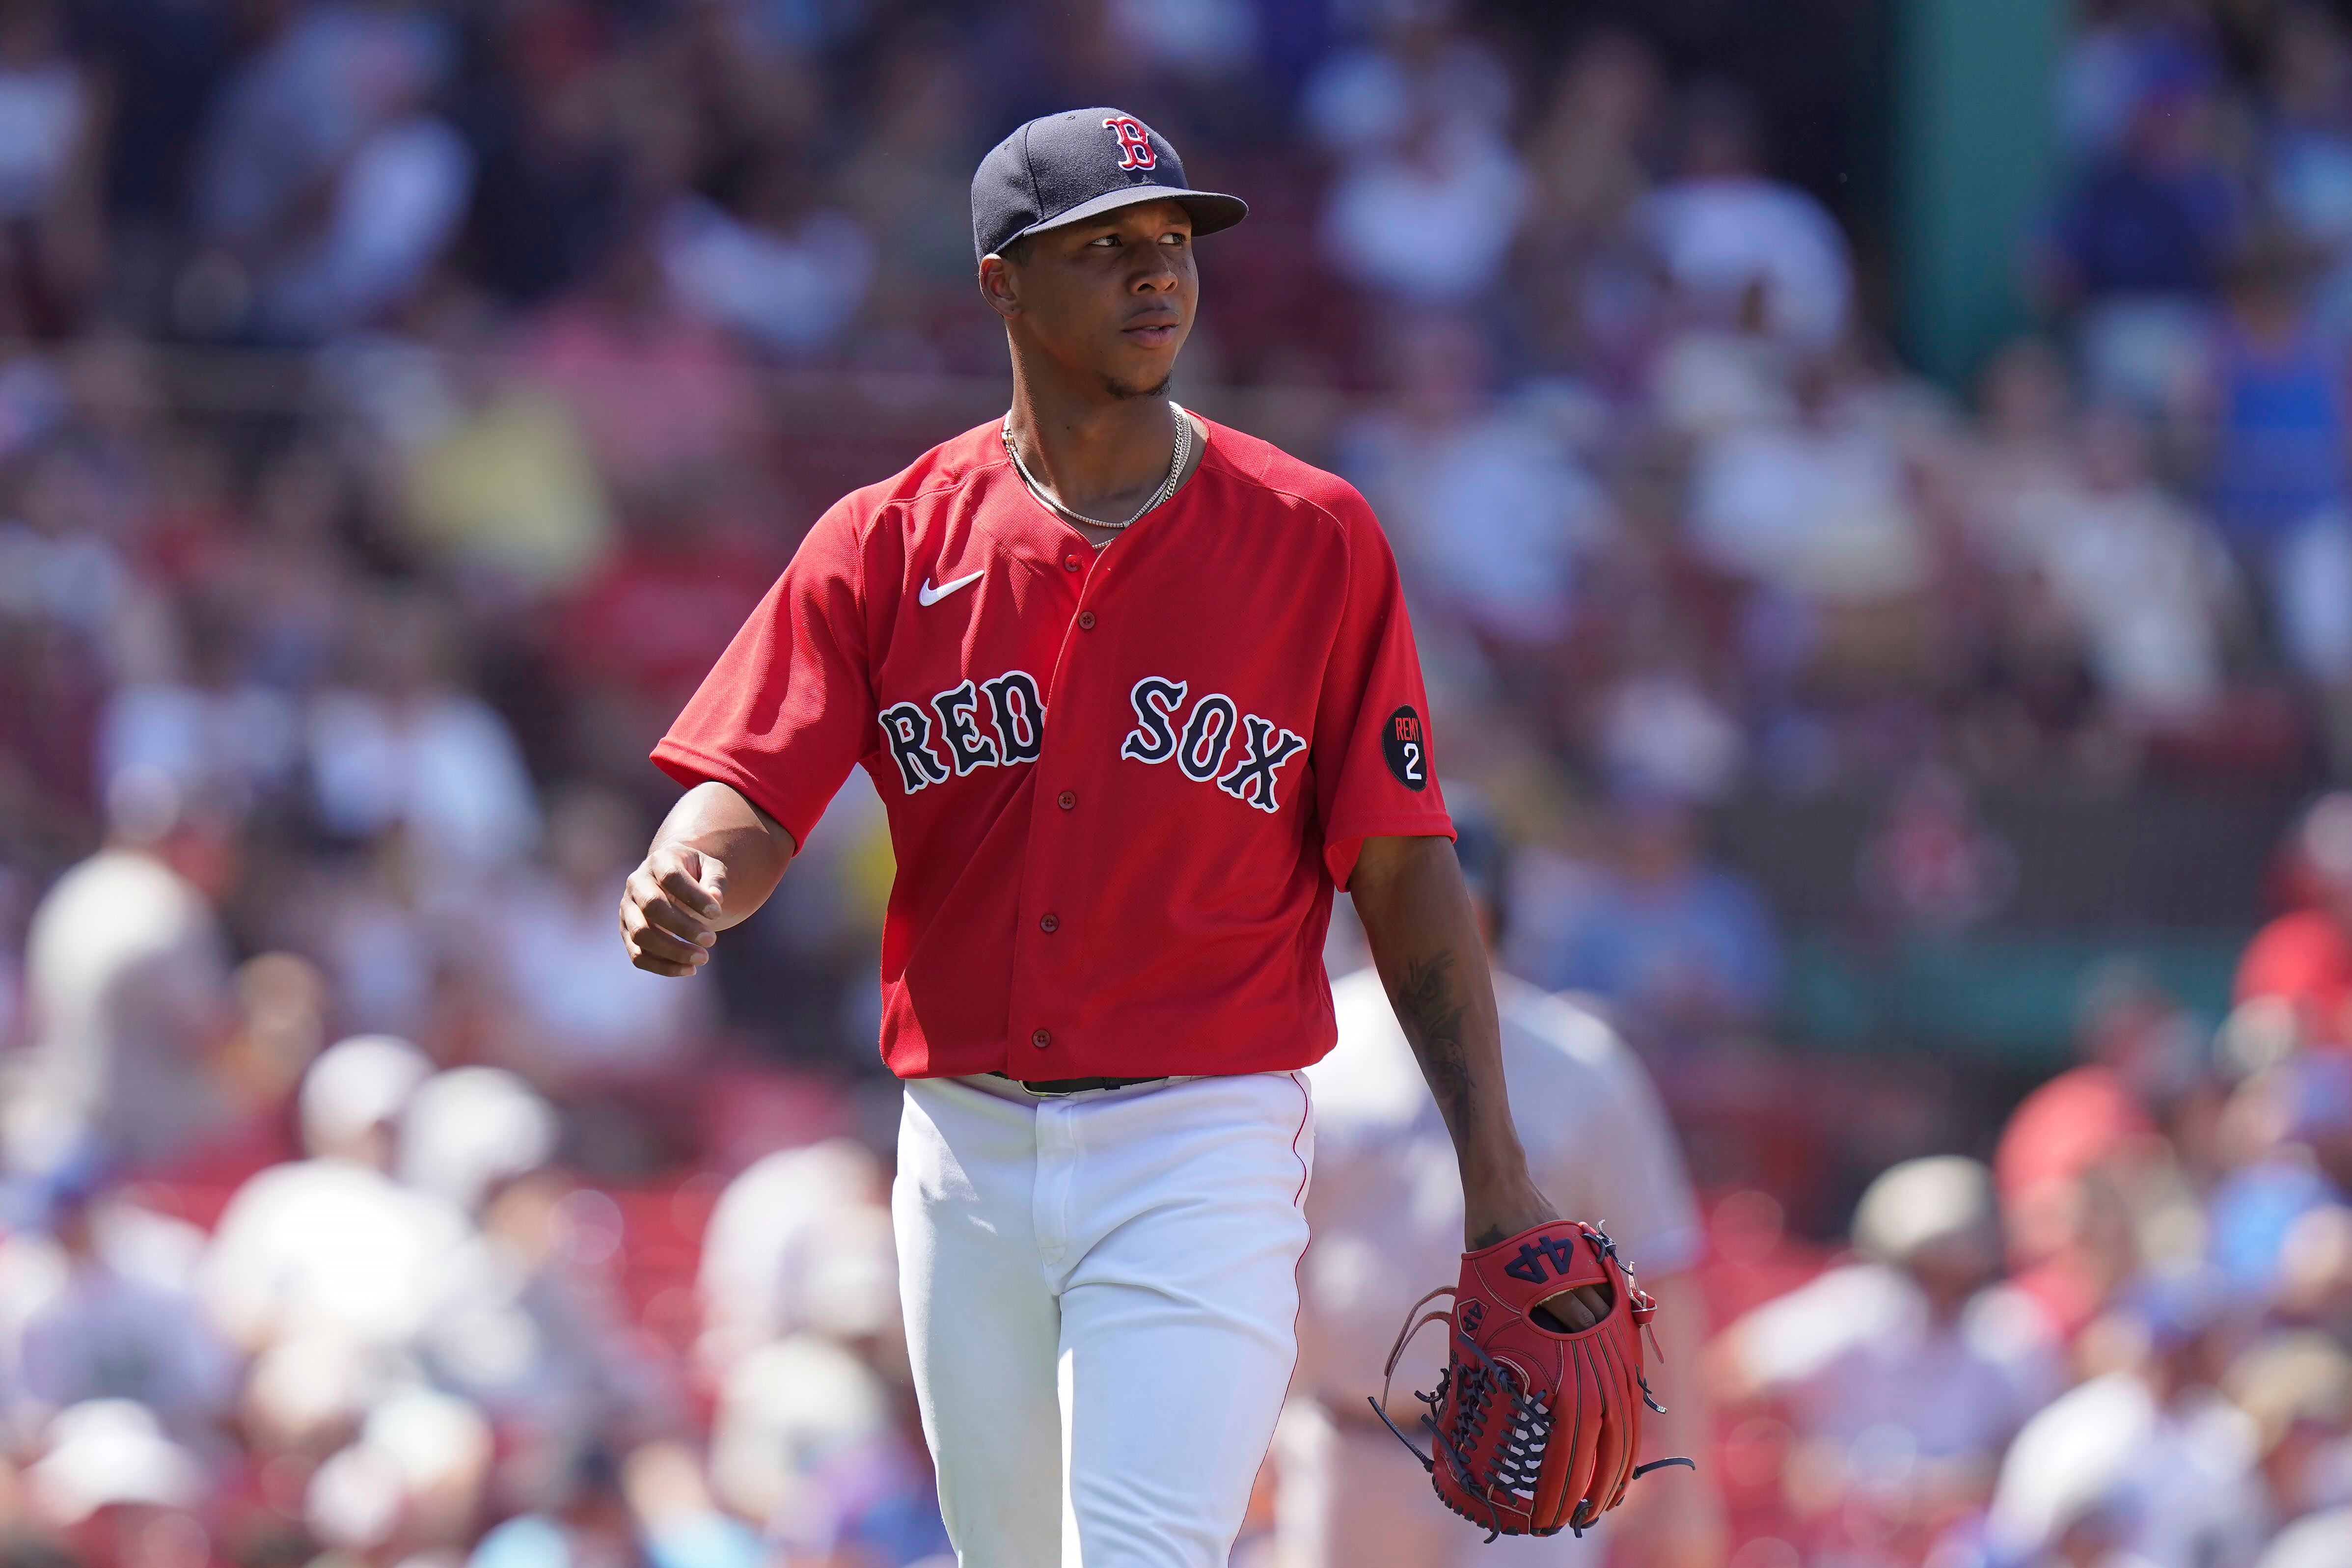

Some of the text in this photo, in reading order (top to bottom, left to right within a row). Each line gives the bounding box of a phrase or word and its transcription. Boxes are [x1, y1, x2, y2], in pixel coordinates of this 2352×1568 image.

[1102, 116, 1157, 171] B
[878, 670, 1307, 813] RED SOX
[1403, 743, 1422, 780] 2
